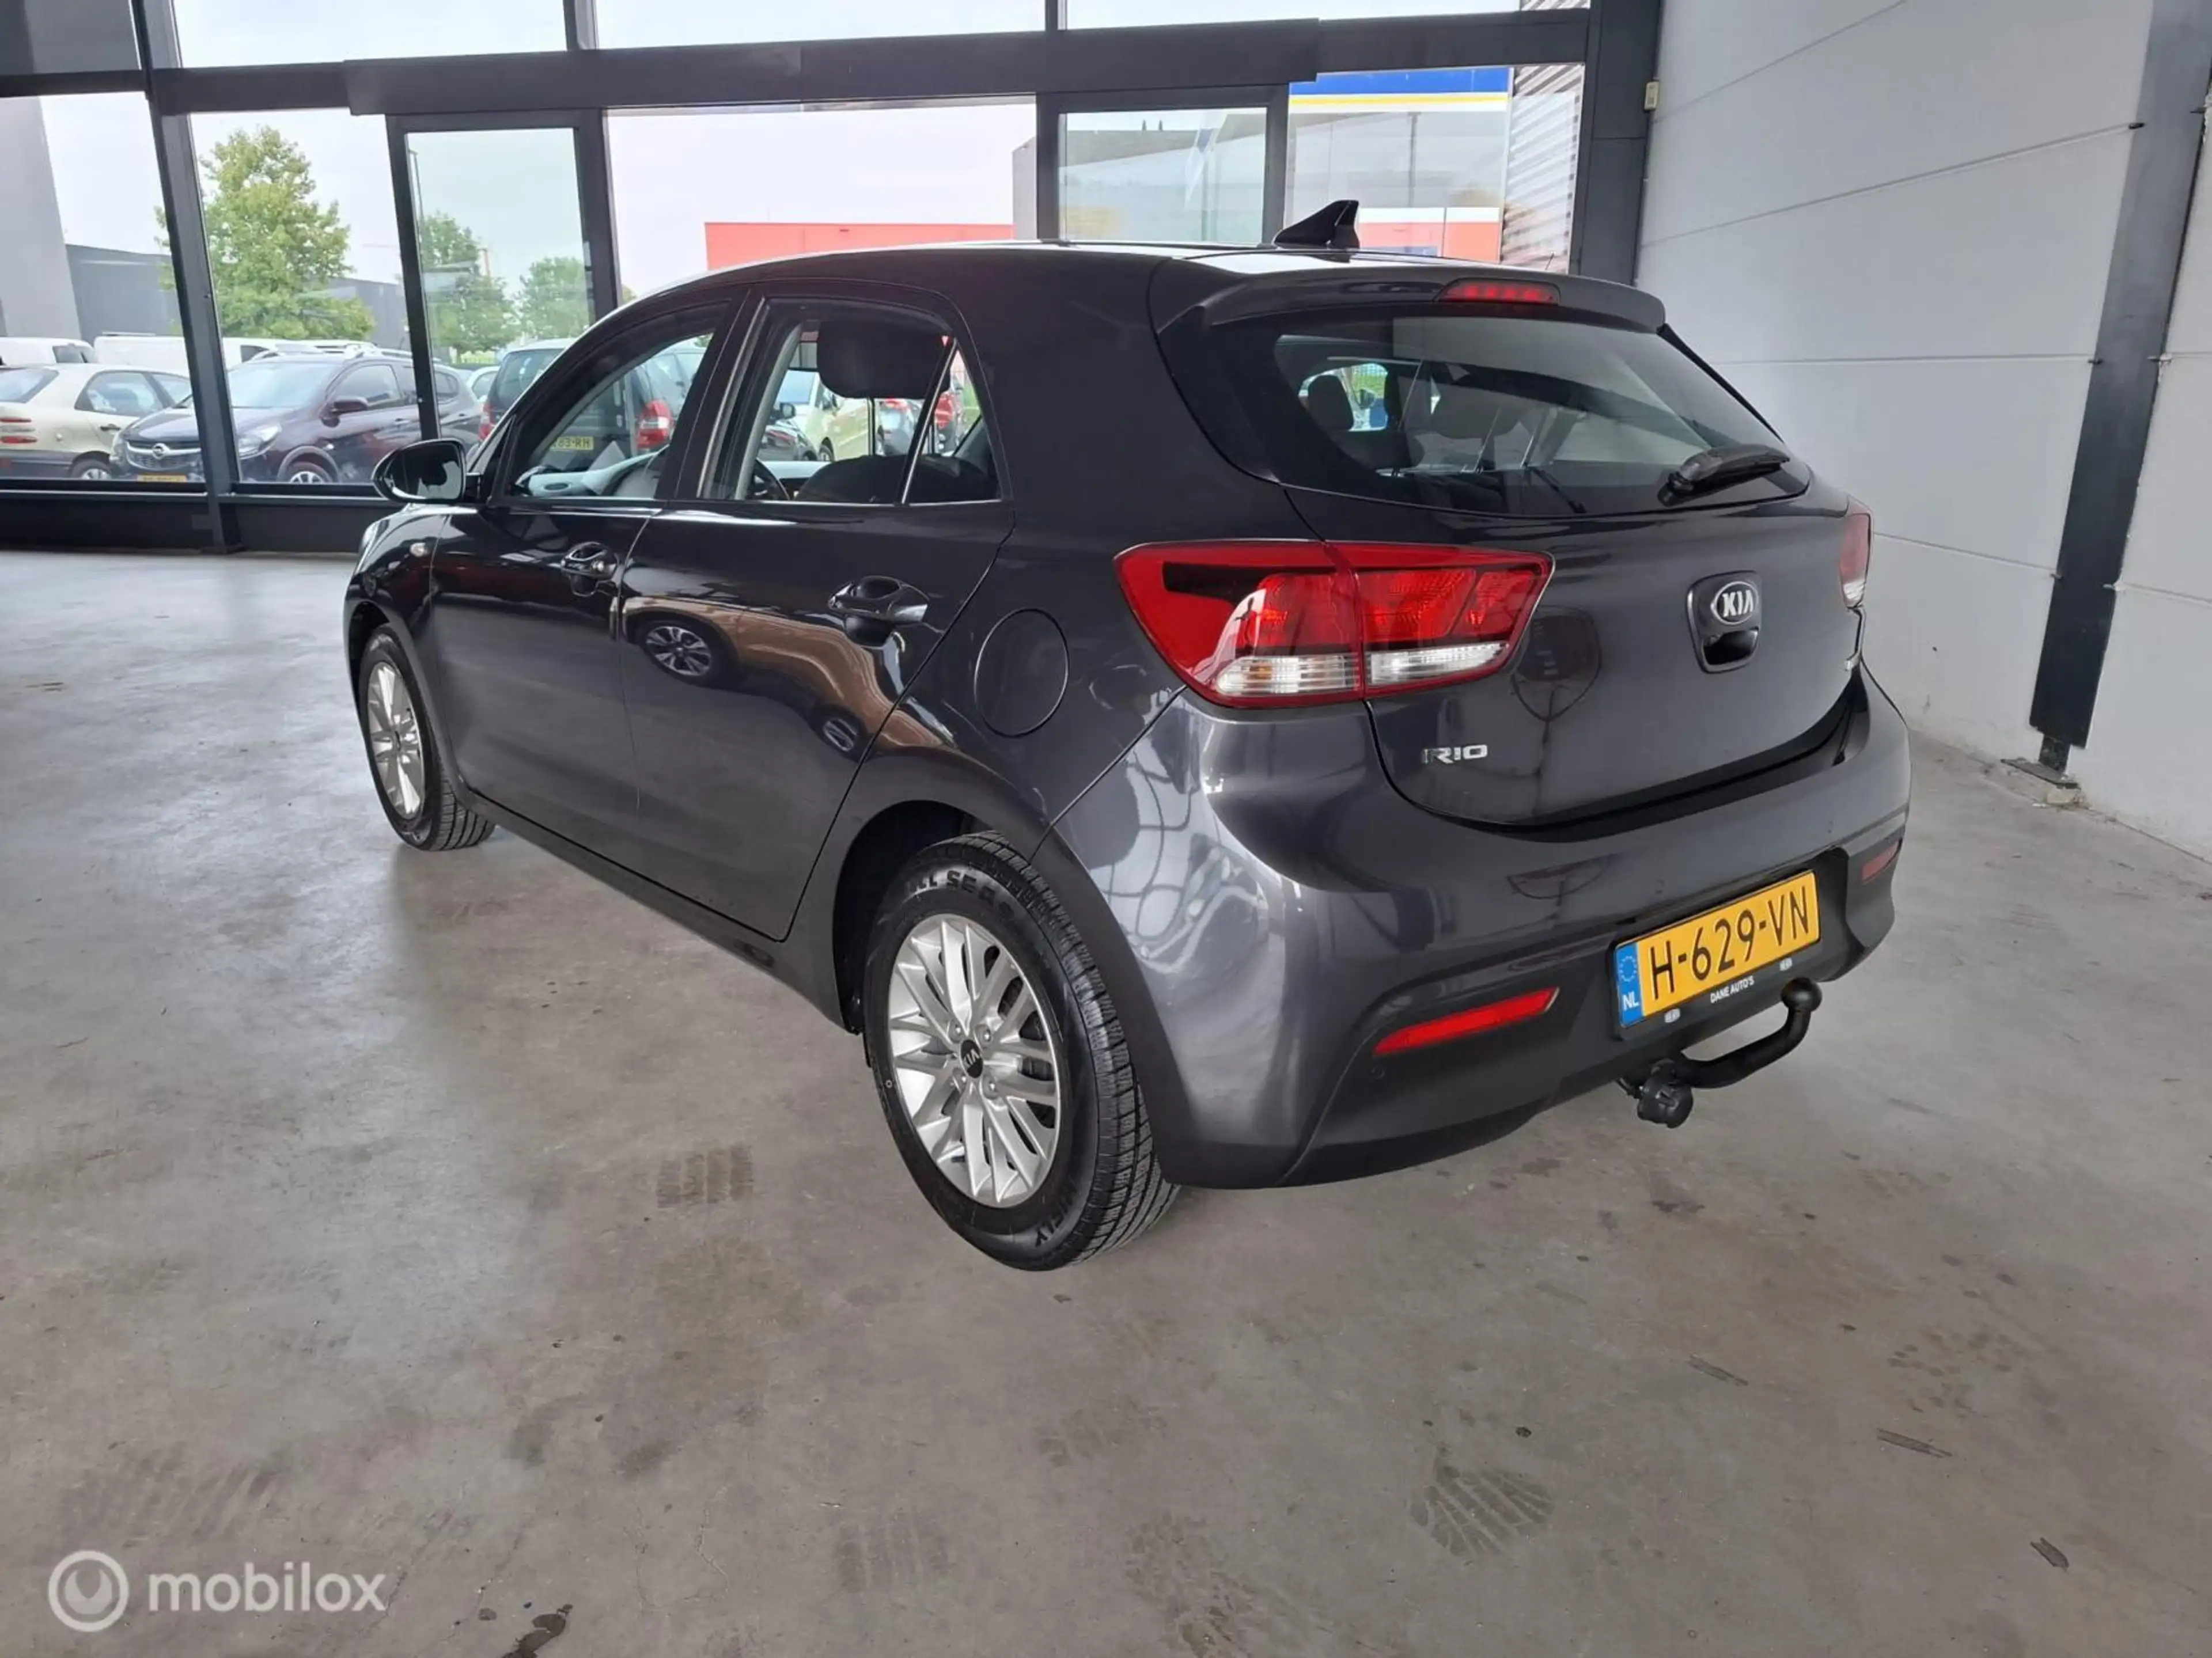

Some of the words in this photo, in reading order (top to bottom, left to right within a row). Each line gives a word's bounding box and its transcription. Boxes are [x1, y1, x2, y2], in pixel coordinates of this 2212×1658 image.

[1722, 589, 1753, 617] KIA
[1423, 745, 1487, 764] RIO
[1650, 886, 1809, 1000] H-629-VN
[1622, 991, 1639, 1011] NL
[1710, 987, 1730, 1003] DANE
[1730, 976, 1754, 994] AUTO'S
